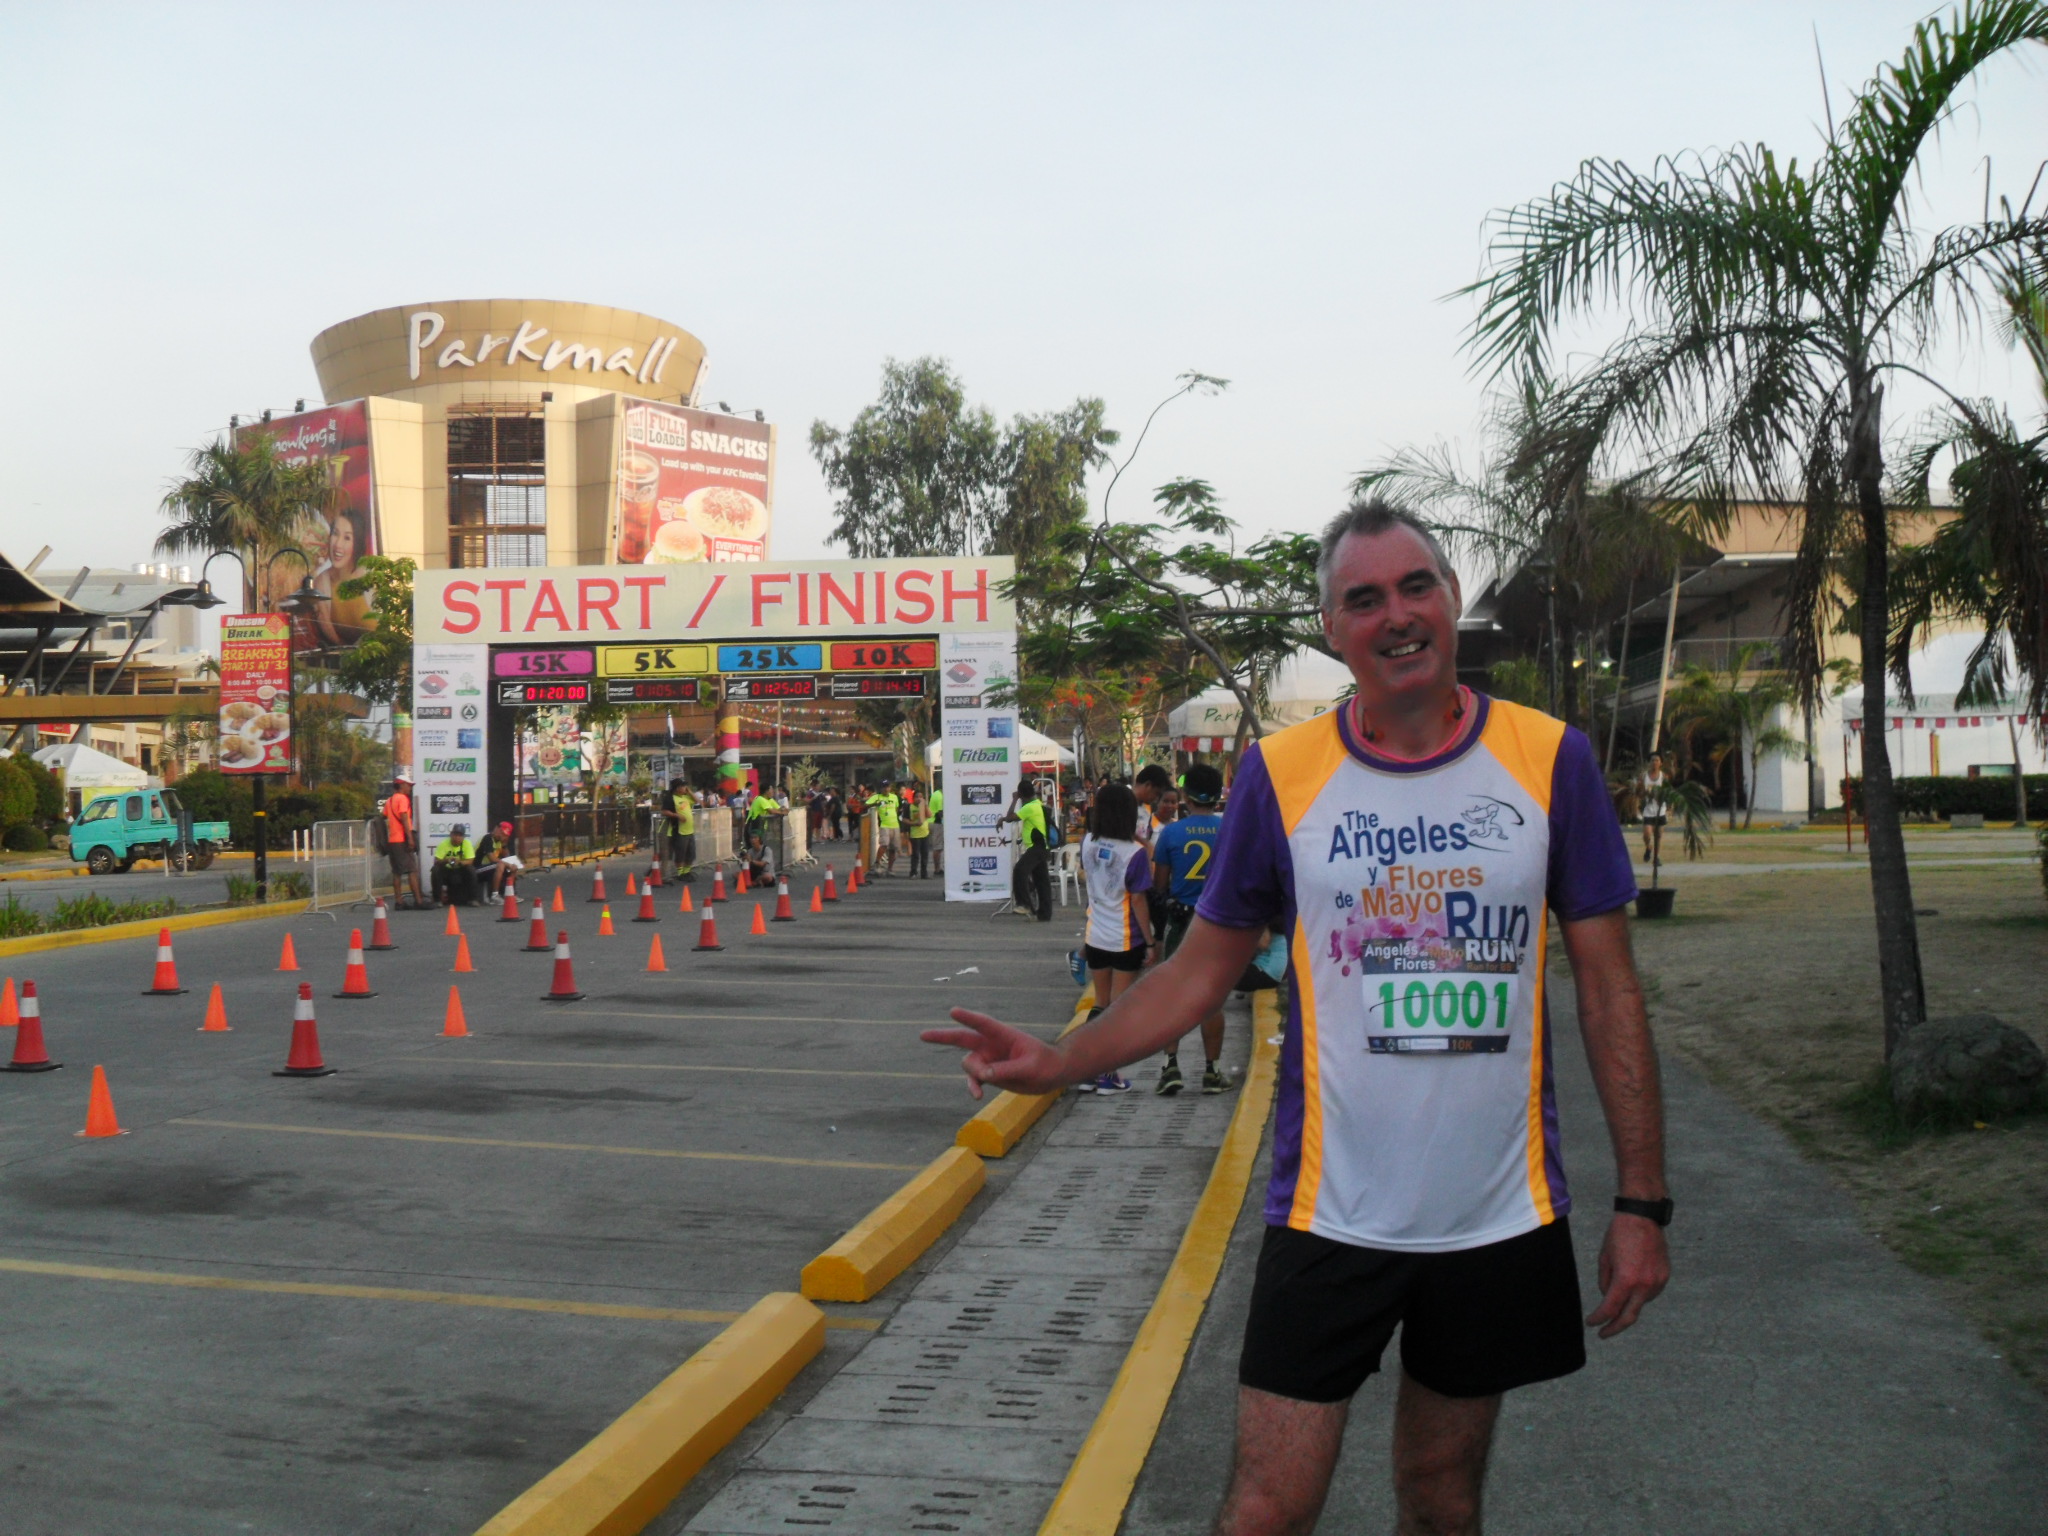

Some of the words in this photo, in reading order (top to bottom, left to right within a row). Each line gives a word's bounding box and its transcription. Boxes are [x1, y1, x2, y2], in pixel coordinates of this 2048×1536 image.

[408, 311, 679, 385] Parkmall
[649, 411, 687, 436] FULLY
[648, 429, 686, 447] LOADED
[690, 429, 768, 461] SNACKS
[661, 457, 680, 469] Load
[680, 461, 689, 473] up
[690, 462, 705, 473] with
[706, 465, 722, 477] your
[722, 467, 739, 478] KFC
[715, 540, 753, 554] EVERYTHING
[754, 545, 762, 554] AT
[442, 576, 667, 635] START
[751, 568, 989, 628] FINISH
[226, 617, 267, 627] DIMSUM
[227, 628, 263, 639] BREAK
[222, 648, 289, 661] BREAKFAST
[519, 652, 570, 674] 15K
[635, 648, 677, 673] 5K
[737, 646, 800, 668] 25K
[853, 645, 913, 667] 10K
[221, 661, 255, 671] STARTS
[258, 661, 270, 670] AT
[430, 758, 473, 773] Fitbar
[959, 748, 1005, 763] Fitbar
[1343, 810, 1379, 831] The
[959, 837, 1007, 848] TIMEX
[1328, 815, 1469, 866] Angeles
[1183, 840, 1212, 880] 2
[1367, 866, 1378, 886] y
[1387, 865, 1484, 892] Flores
[1335, 891, 1353, 909] de
[1362, 885, 1443, 923] Mayo
[1445, 891, 1530, 949] Run
[1365, 943, 1418, 960] Angeles
[1465, 939, 1516, 963] RUN
[1394, 958, 1436, 971] Flores
[1379, 980, 1509, 1029] 10001
[1452, 1039, 1474, 1051] 10K
